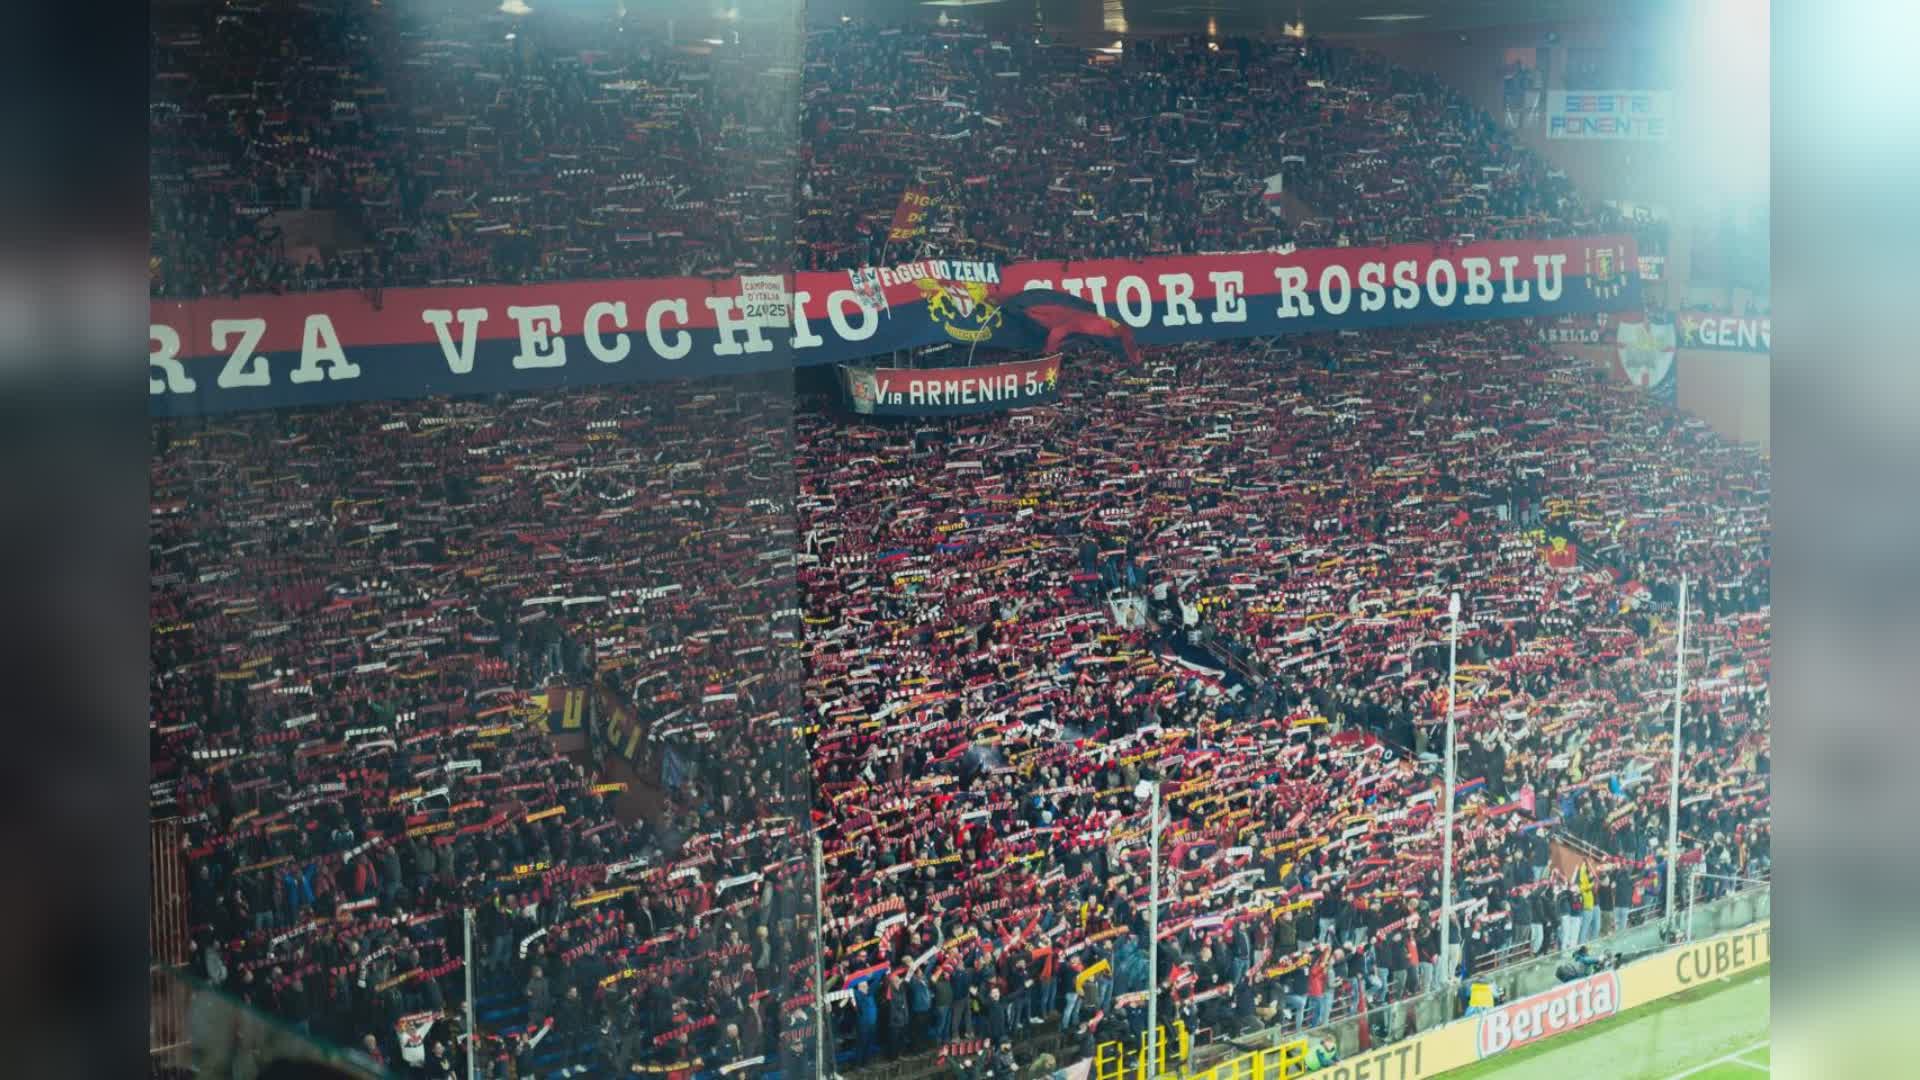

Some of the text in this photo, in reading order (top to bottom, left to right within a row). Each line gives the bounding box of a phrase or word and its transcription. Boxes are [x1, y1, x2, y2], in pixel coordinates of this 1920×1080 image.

[1566, 95, 1656, 112] SESTR
[1551, 116, 1664, 135] PONENTE
[952, 260, 1000, 284] ZENA
[422, 290, 879, 374] VECCHIO
[1024, 271, 1247, 328] UORE
[1274, 254, 1567, 318] ROSSOBLU
[746, 303, 786, 317] 24 25
[909, 373, 1018, 407] ARMENIA
[1487, 980, 1613, 1052] Beretta
[1321, 1041, 1422, 1080] ETTI
